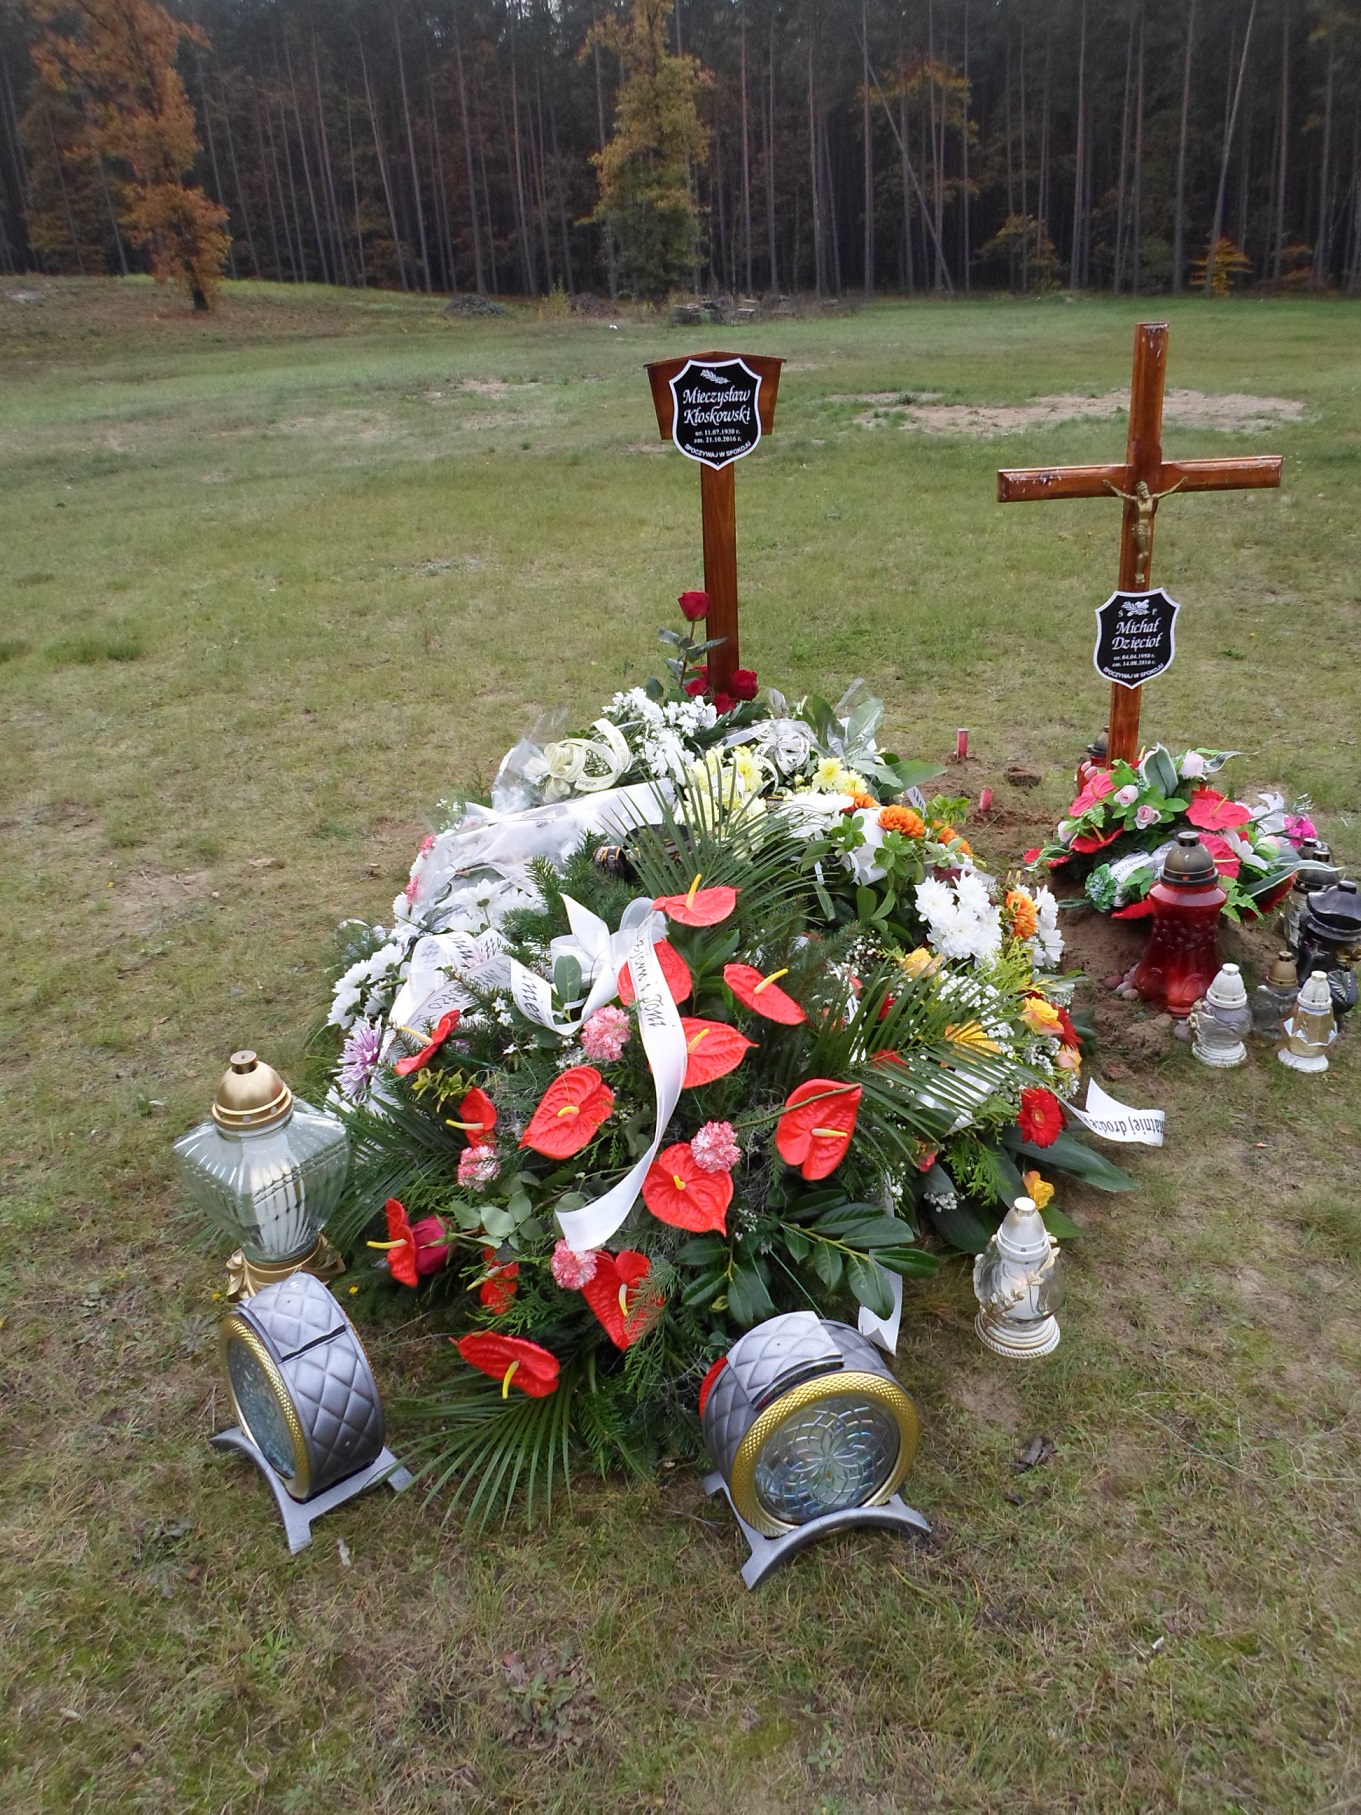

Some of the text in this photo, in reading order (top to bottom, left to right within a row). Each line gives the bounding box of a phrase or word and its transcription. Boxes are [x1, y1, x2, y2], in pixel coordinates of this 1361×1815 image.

[682, 385, 751, 408] Mieczysław
[683, 404, 751, 426] Kłoskowski
[684, 443, 719, 458] SPOCZYWAJ
[725, 440, 752, 457] SPOKOJU
[1115, 617, 1162, 635] Michał
[1111, 632, 1164, 652] Dzięcioł
[1103, 666, 1133, 679] SPOCZYWAJ
[1140, 662, 1164, 678] SPOKOJU
